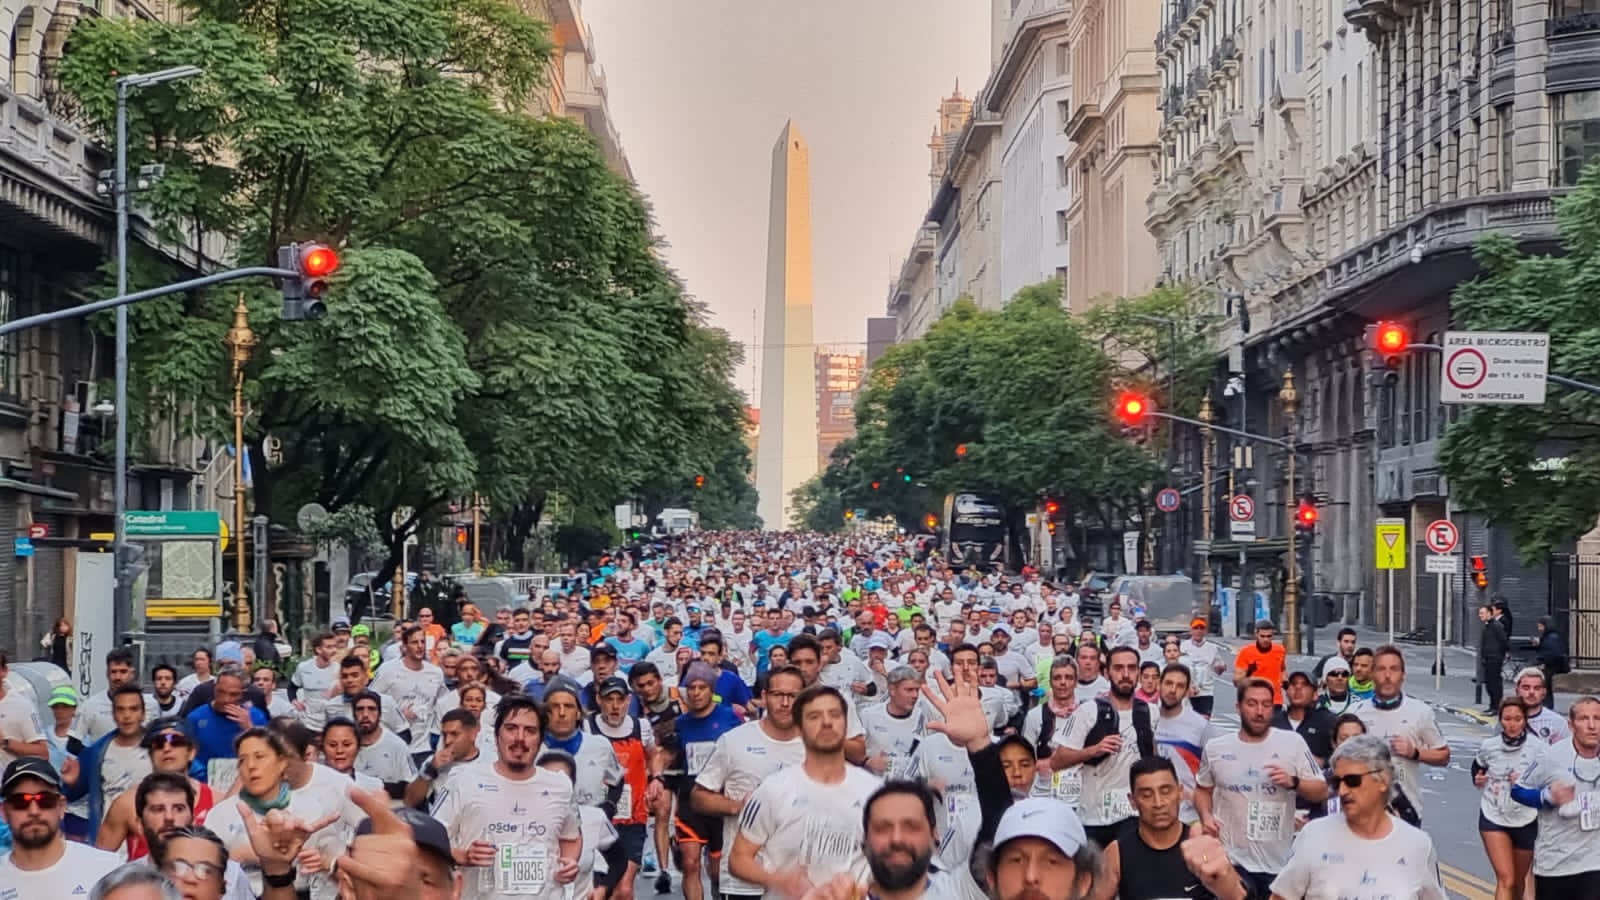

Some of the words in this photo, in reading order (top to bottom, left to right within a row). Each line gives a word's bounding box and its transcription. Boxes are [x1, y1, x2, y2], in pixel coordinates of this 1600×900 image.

[1448, 338, 1473, 346] AREA
[1477, 338, 1546, 347] MICROCENTRO
[1460, 392, 1474, 400] NO
[1477, 392, 1525, 400] INGRESAR
[126, 514, 168, 524] Catedral
[1436, 527, 1449, 546] E
[488, 822, 518, 834] osde
[512, 861, 545, 881] 19835
